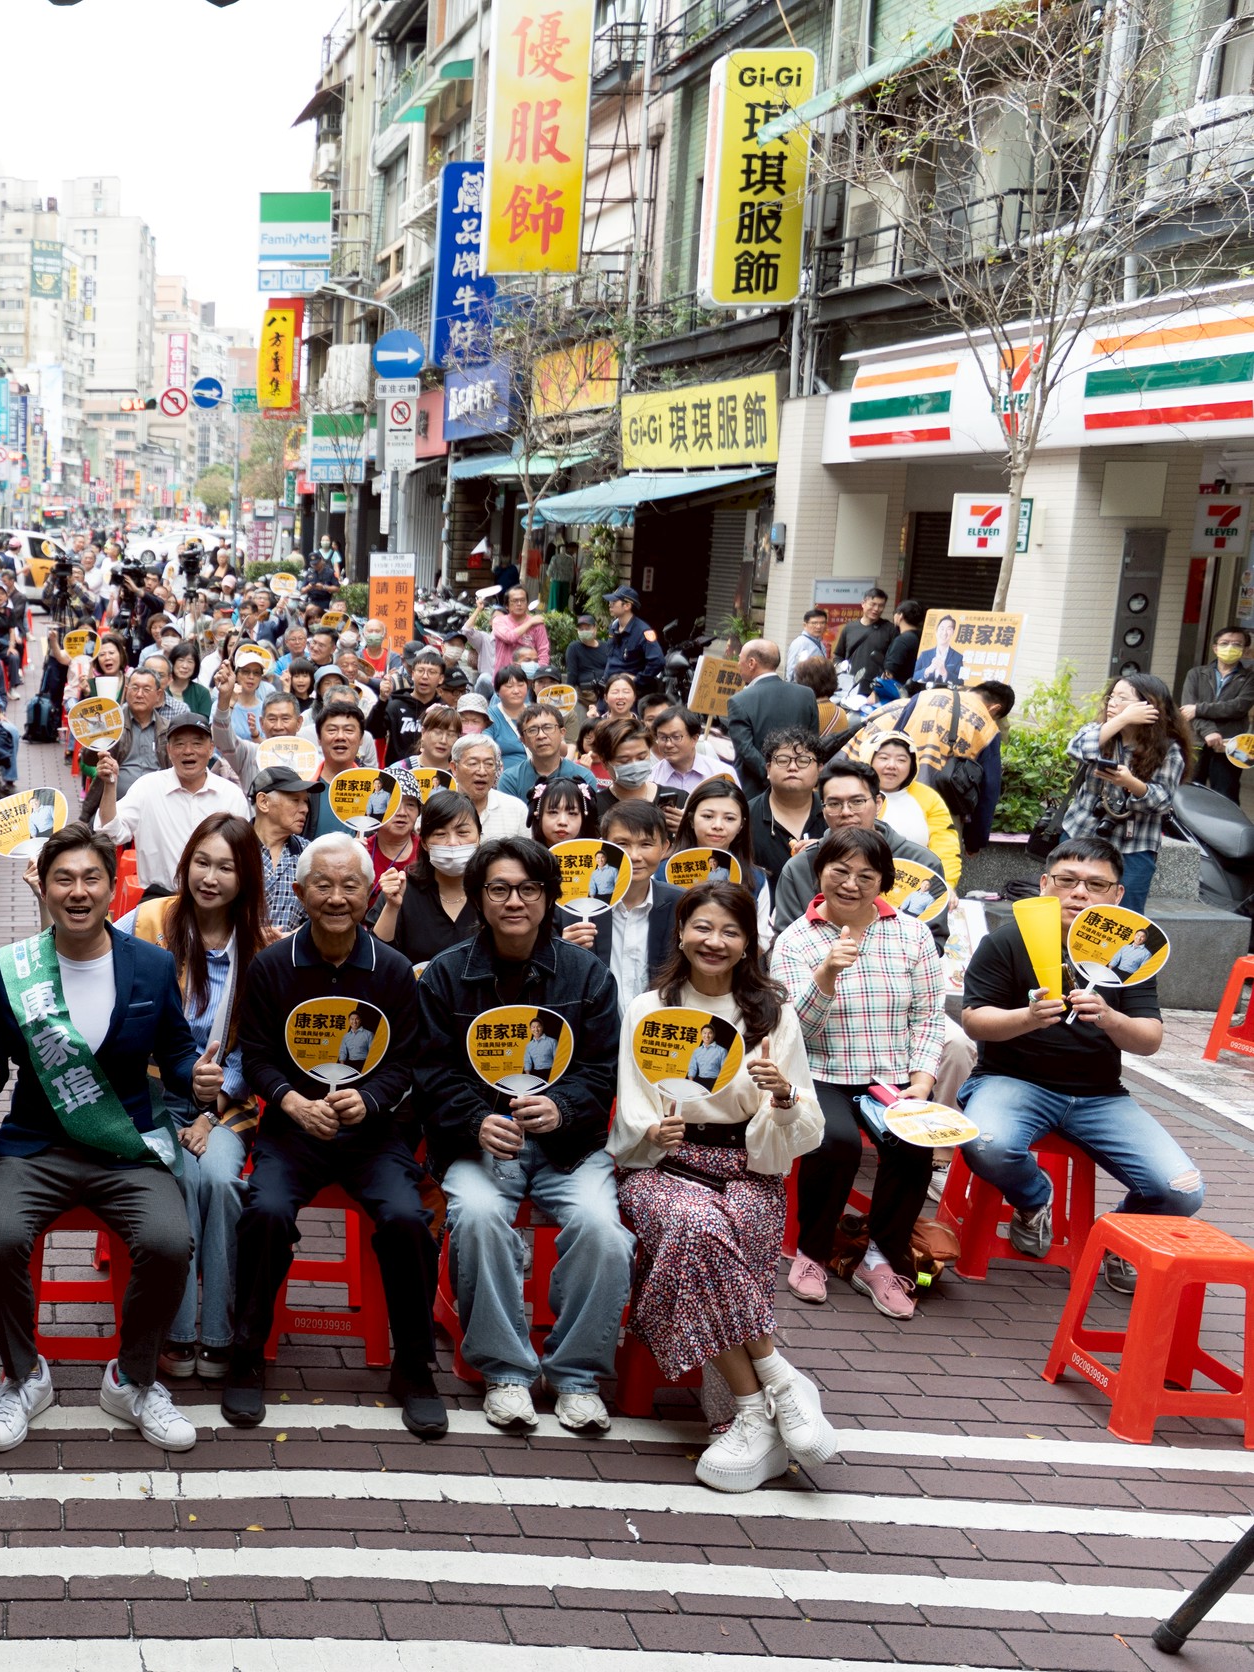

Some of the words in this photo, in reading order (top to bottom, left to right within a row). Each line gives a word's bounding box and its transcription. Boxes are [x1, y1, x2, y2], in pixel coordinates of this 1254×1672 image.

[738, 67, 802, 88] Gi-Gi
[502, 10, 575, 255] 優服飾
[731, 100, 790, 295] 琪琪服飾
[261, 233, 327, 246] FamilyMart
[284, 275, 300, 285] ATM
[450, 218, 480, 349] 品牌牛仔
[170, 335, 185, 387] 廣告出租
[378, 384, 416, 394] 僅准右轉
[629, 414, 662, 446] Gi-Gi
[669, 391, 767, 453] 琪琪服飾
[394, 582, 408, 648] 前方道路
[955, 624, 1016, 647] 康家瑋
[335, 779, 372, 792] 康家瑋
[671, 861, 708, 874] 康家瑋
[896, 869, 920, 888] 家瑋
[1083, 911, 1133, 941] 康家瑋
[295, 1013, 346, 1030] 康家瑋
[476, 1023, 528, 1040] 康家瑋
[642, 1021, 698, 1044] 康家瑋
[20, 980, 104, 1114] 康家瑋
[294, 1317, 351, 1331] 0920939936
[1072, 1352, 1108, 1388] 0920939936
